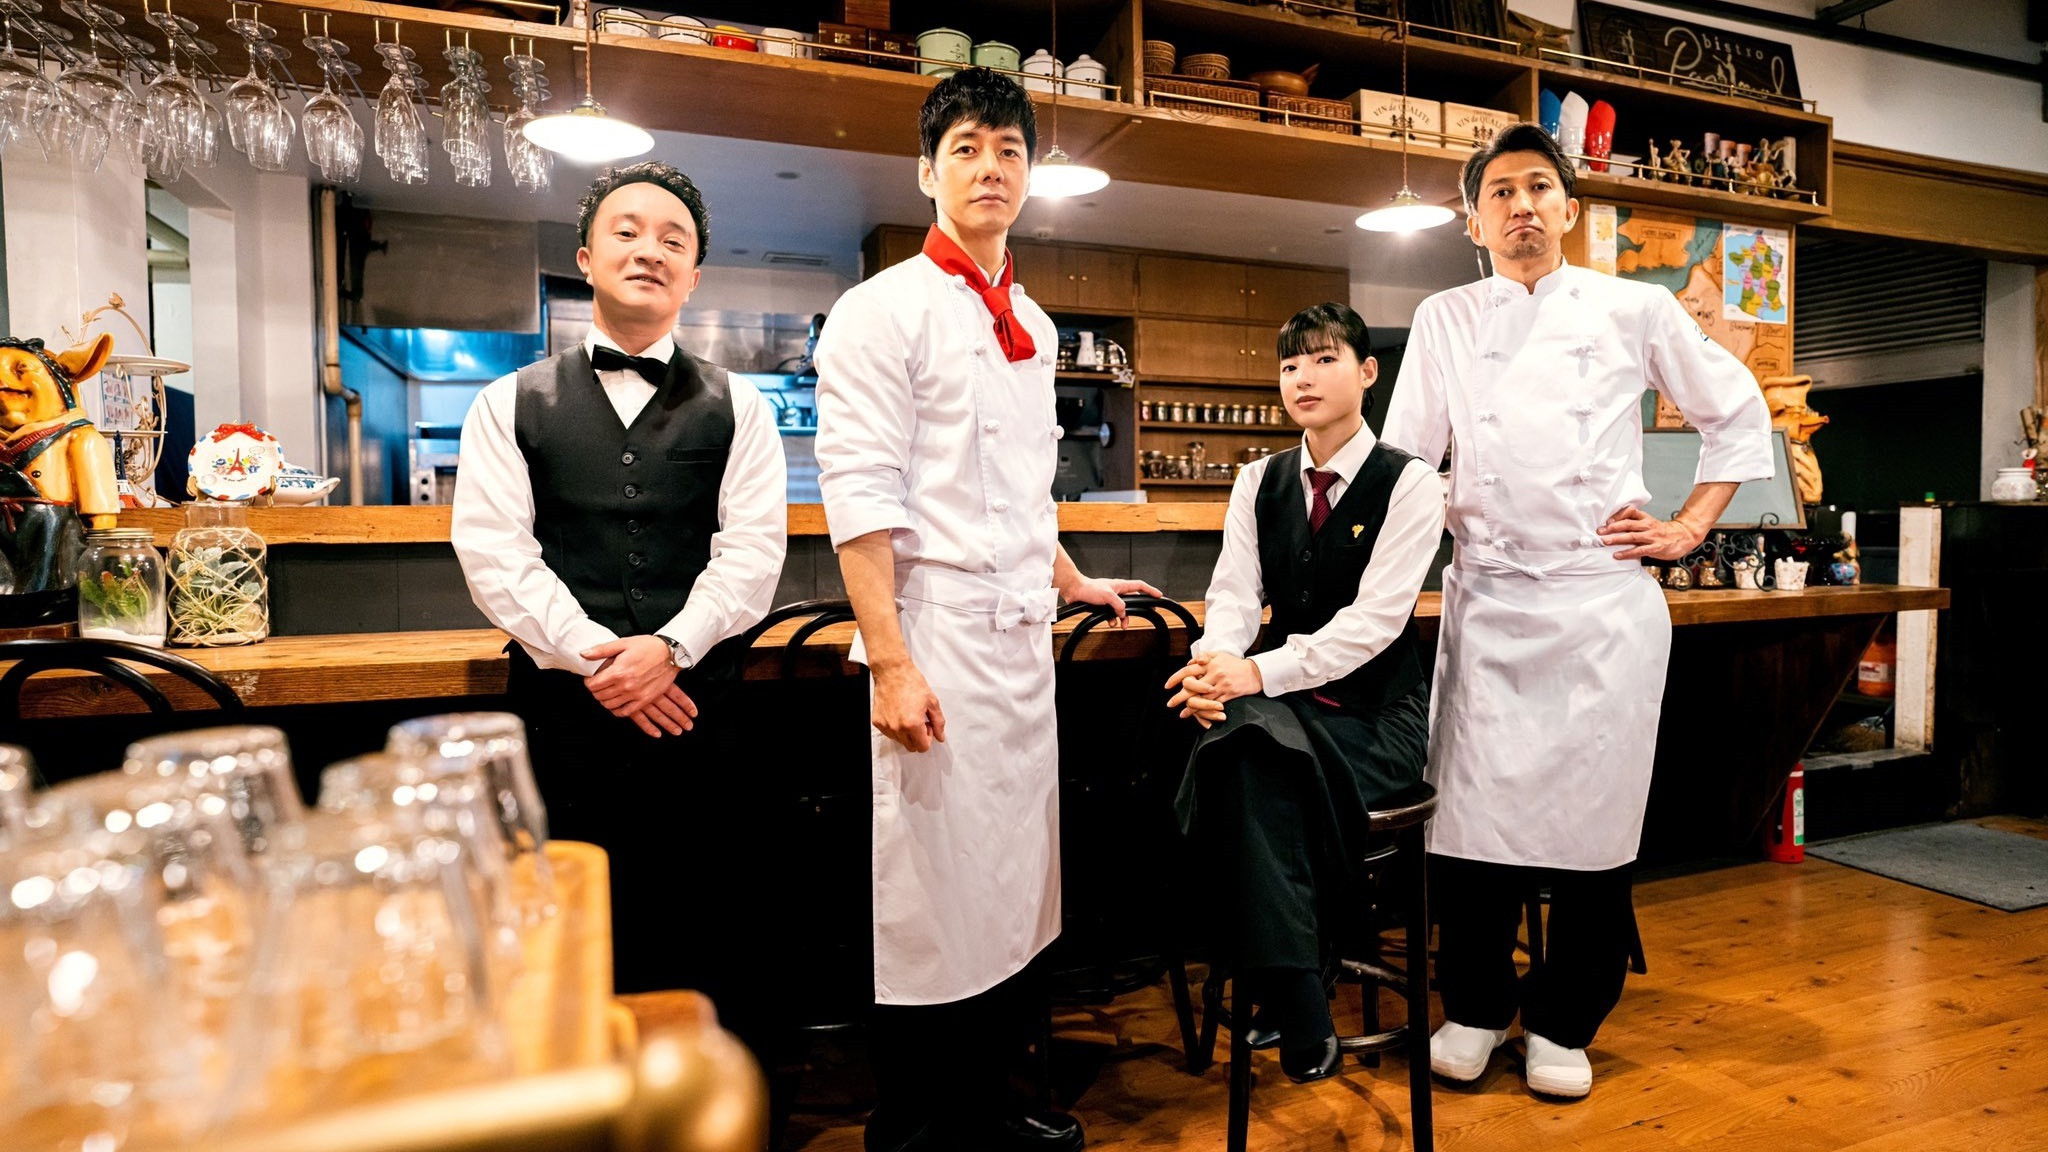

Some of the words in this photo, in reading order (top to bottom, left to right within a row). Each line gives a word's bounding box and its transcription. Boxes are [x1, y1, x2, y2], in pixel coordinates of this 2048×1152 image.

[1702, 33, 1764, 60] bistro
[1373, 105, 1388, 116] VIN
[1456, 117, 1470, 128] VIN
